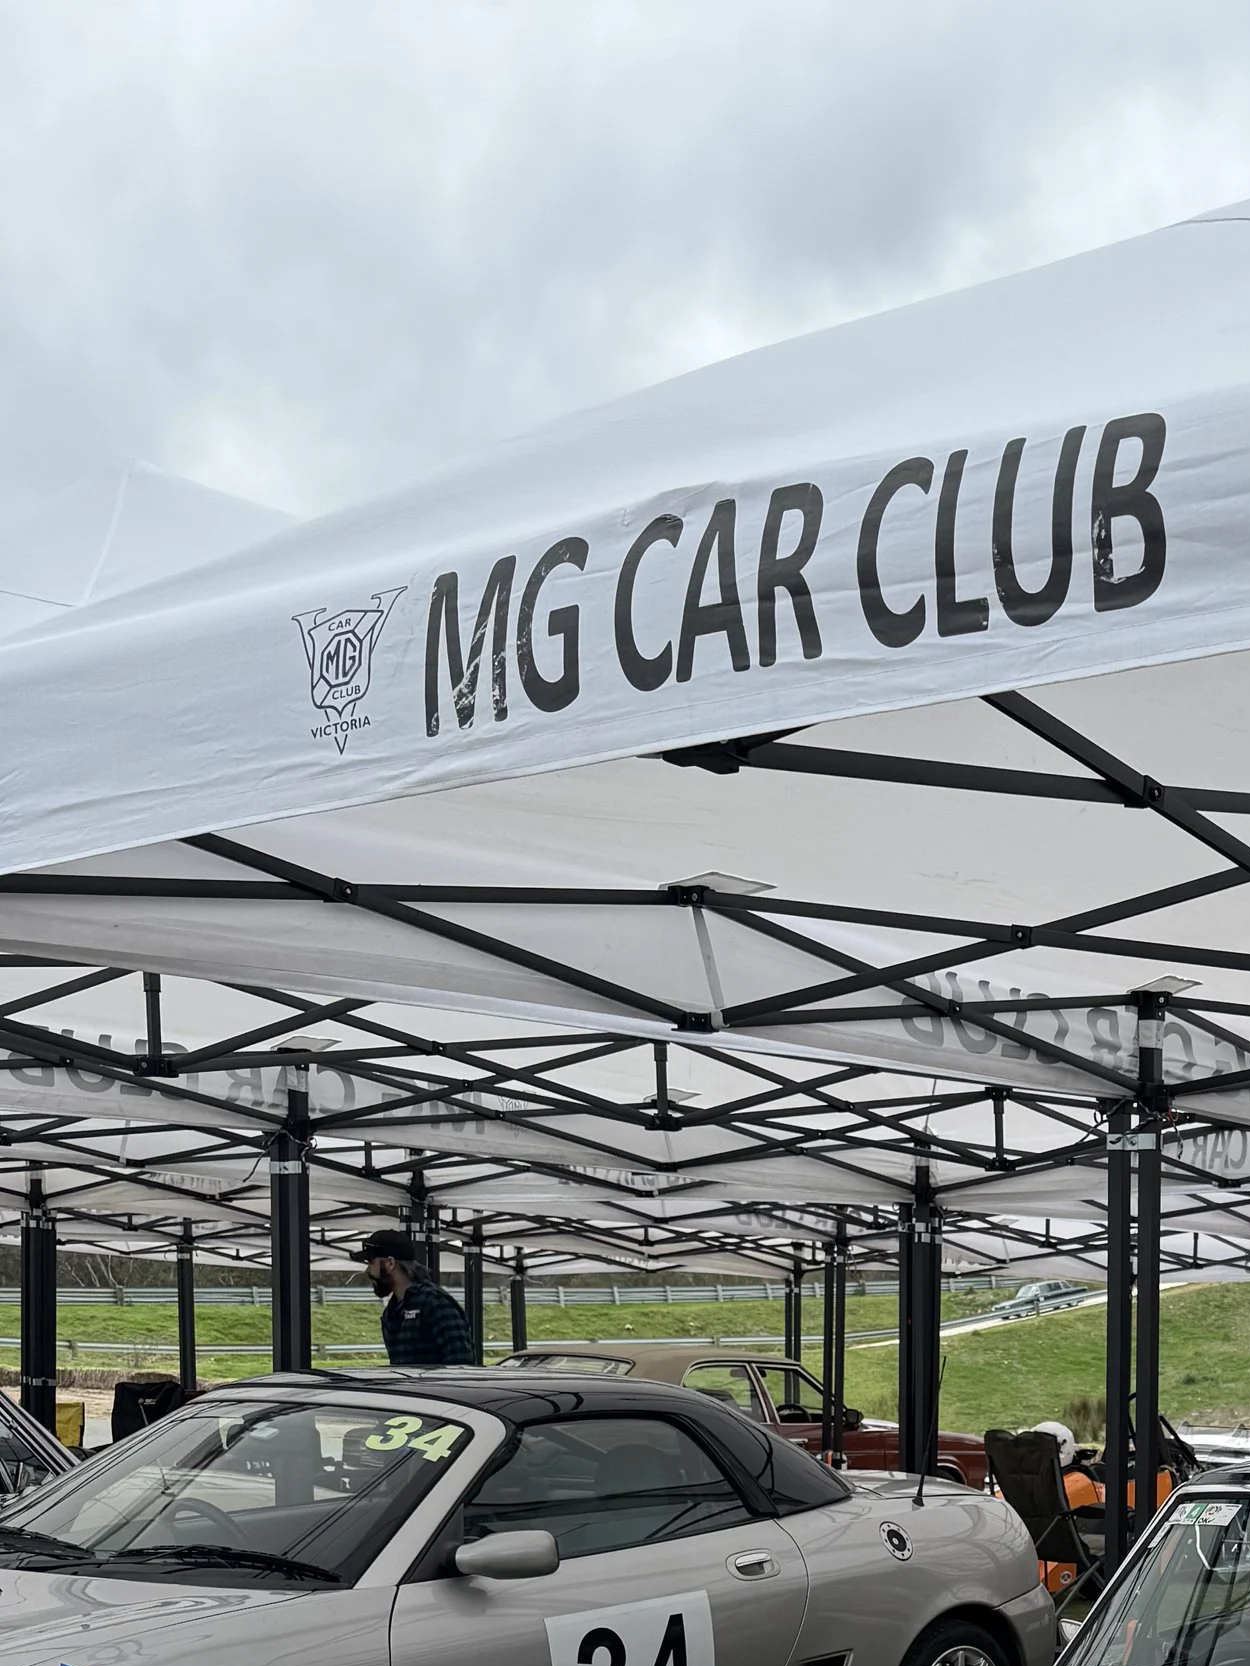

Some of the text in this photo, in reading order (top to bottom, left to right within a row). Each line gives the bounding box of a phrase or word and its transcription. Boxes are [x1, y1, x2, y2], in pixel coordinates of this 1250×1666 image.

[424, 412, 1167, 738] MG CAR CLUB
[327, 618, 352, 631] CAR
[326, 637, 356, 680] MG
[332, 685, 361, 700] CLUB
[311, 716, 371, 739] VICTORIA
[365, 1416, 465, 1462] 34
